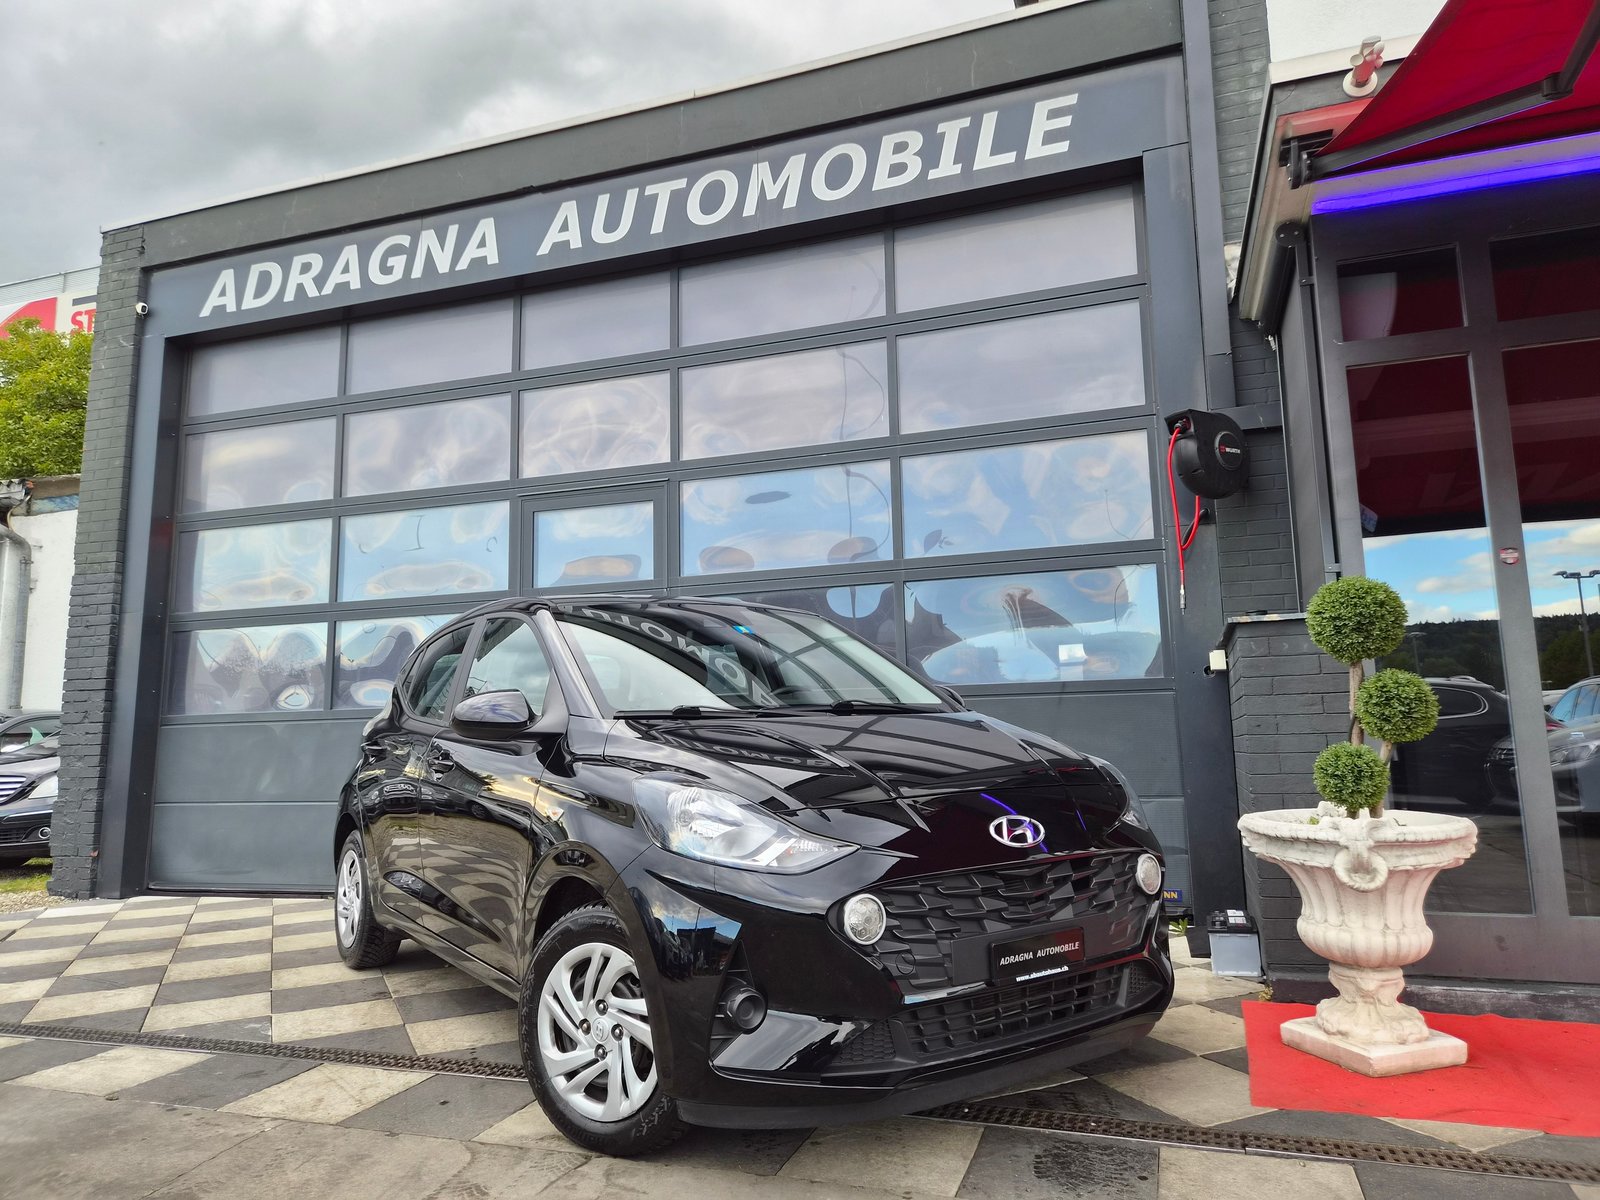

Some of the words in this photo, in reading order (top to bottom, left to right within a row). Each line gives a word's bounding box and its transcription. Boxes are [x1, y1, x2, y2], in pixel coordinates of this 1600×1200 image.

[199, 217, 499, 317] ADRAGNA
[536, 93, 1078, 256] AUTOMOBILE
[1000, 951, 1033, 966] ADRAGNA
[1037, 941, 1079, 958] AUTOMOBILE
